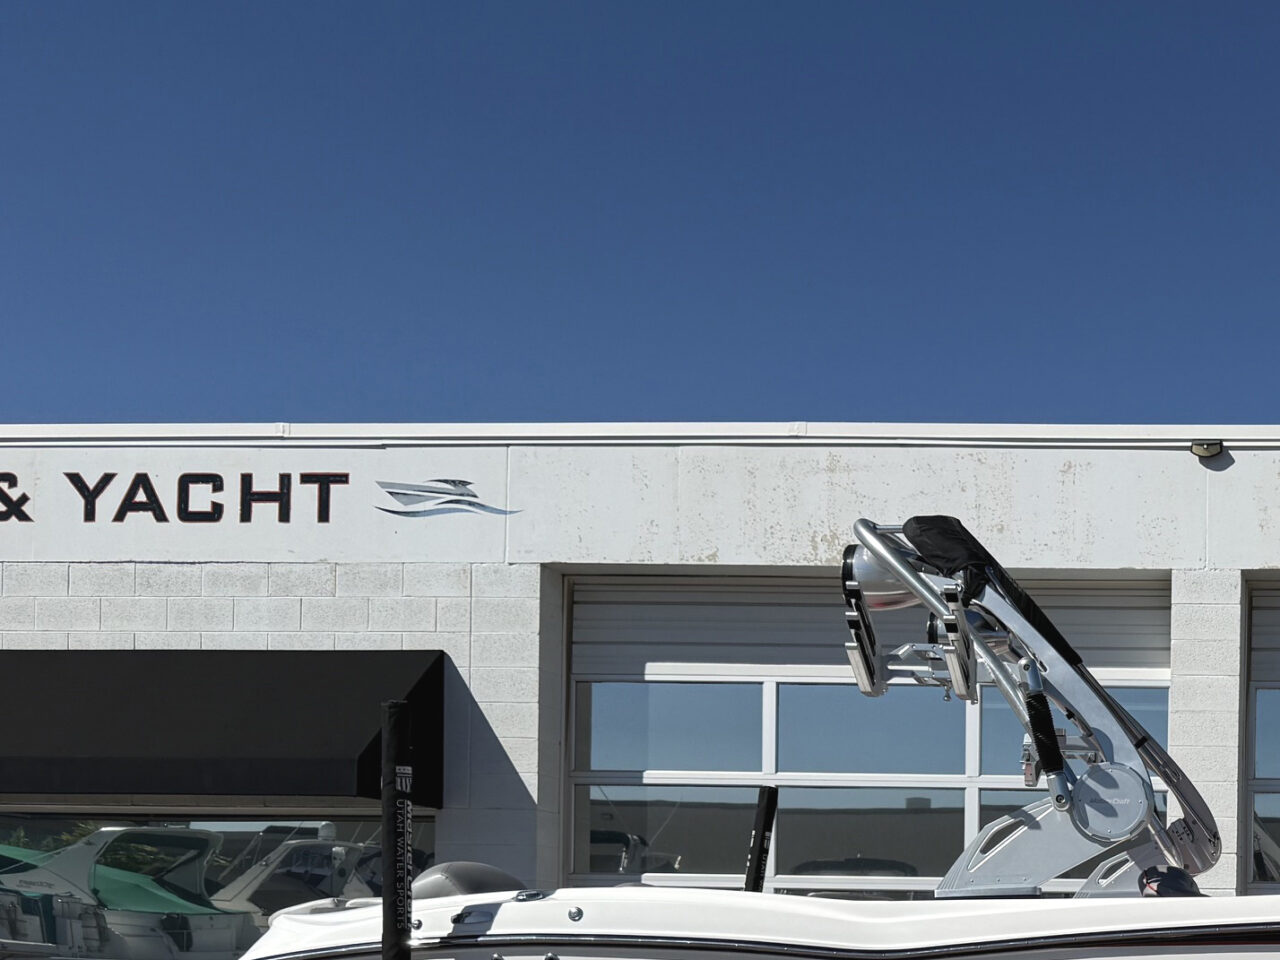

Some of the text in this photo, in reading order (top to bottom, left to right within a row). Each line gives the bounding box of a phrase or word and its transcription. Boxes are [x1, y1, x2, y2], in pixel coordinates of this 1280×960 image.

[0, 471, 350, 523] & YACHT
[396, 799, 405, 929] UTAH WATER SPORTS
